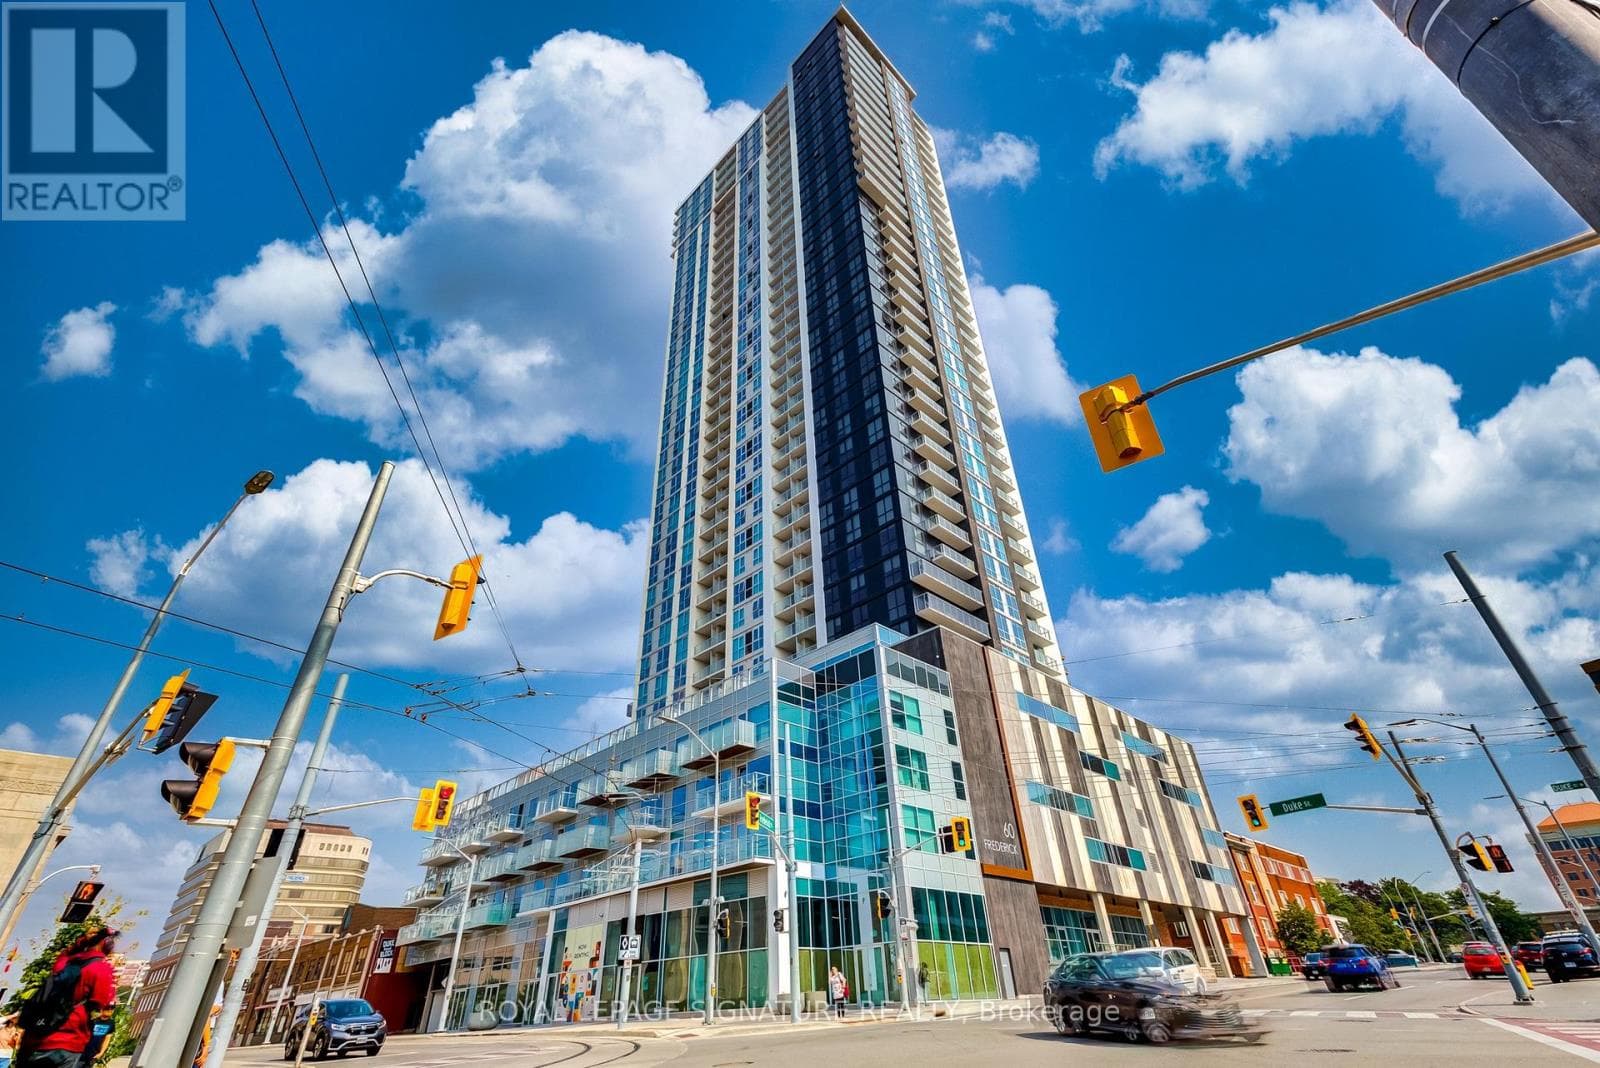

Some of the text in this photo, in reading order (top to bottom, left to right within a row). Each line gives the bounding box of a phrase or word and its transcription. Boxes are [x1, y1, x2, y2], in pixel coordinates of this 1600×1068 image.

[1281, 801, 1303, 813] Duke
[1003, 822, 1015, 839] 60
[983, 838, 1018, 855] FREDERICK
